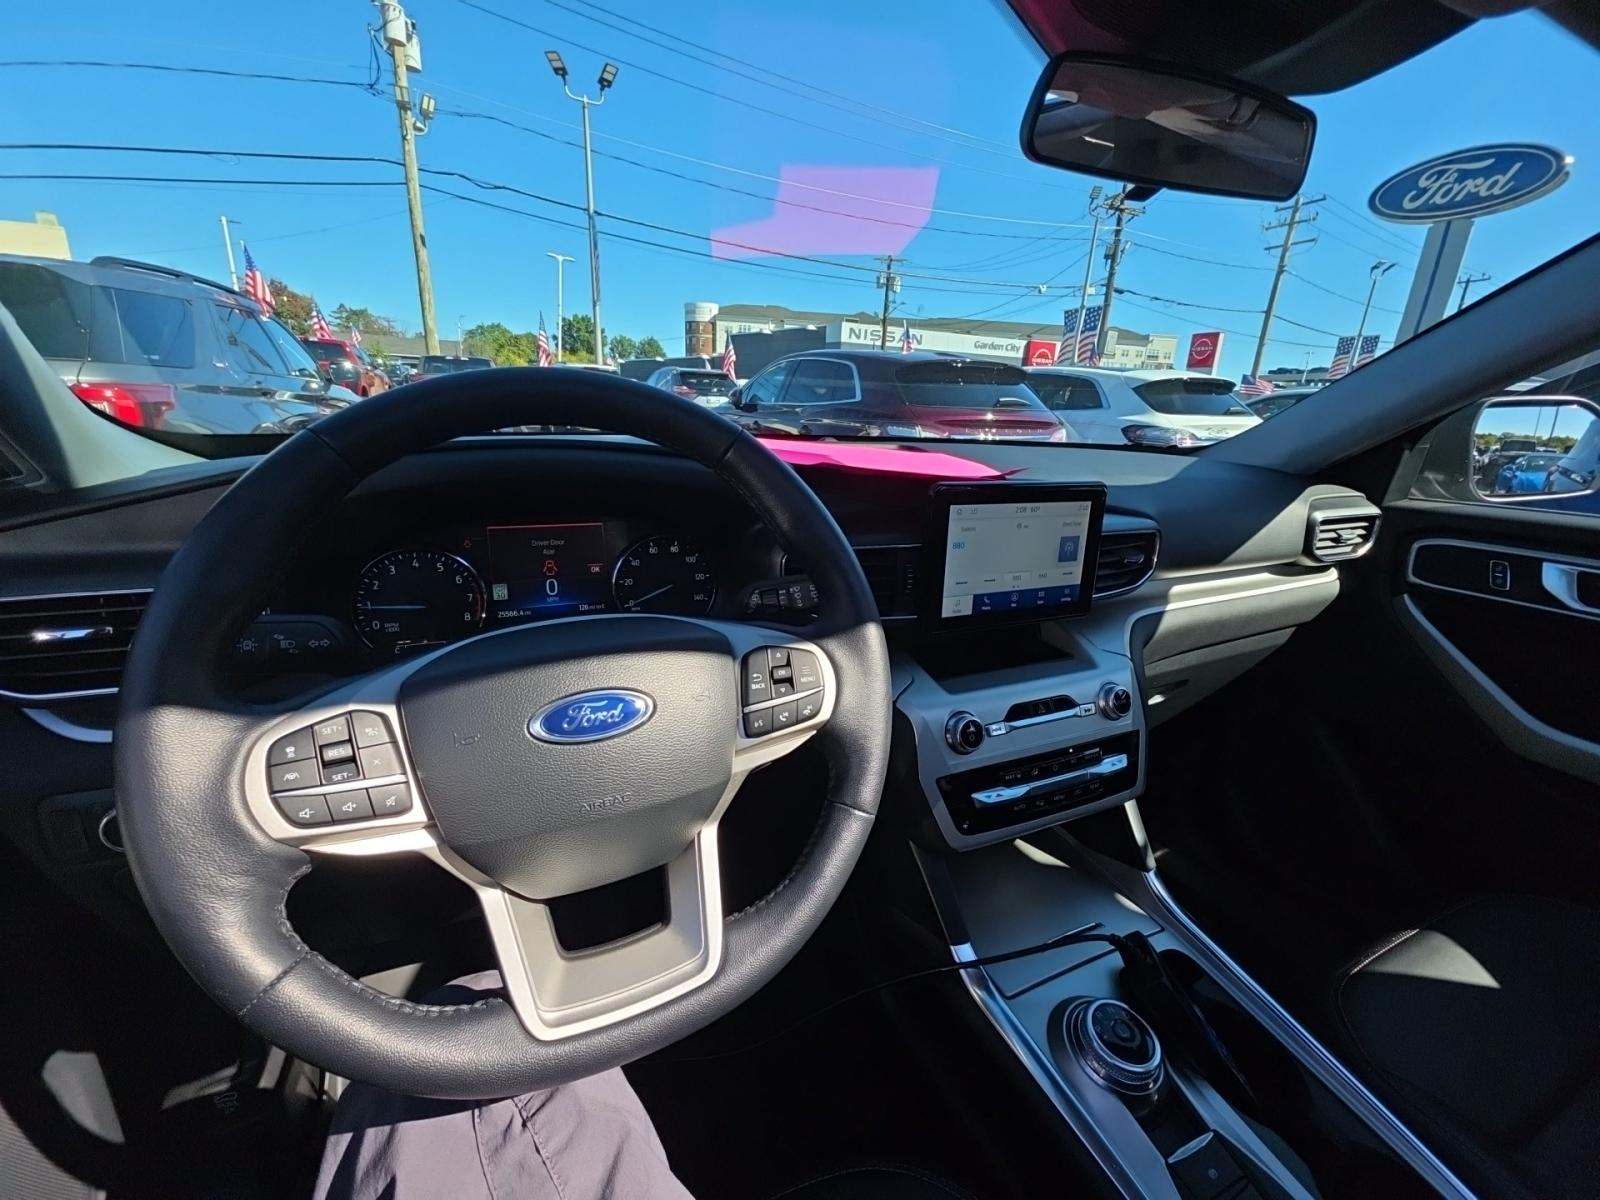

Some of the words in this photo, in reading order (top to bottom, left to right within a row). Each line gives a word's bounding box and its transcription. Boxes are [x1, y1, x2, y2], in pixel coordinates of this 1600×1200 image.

[1402, 158, 1523, 210] Ford
[974, 341, 1004, 352] Garden
[1005, 343, 1020, 353] City
[412, 559, 420, 568] 4
[437, 562, 444, 572] 5
[389, 565, 396, 575] 3
[455, 575, 462, 584] 6
[372, 581, 380, 590] 2
[546, 578, 558, 595] 0
[464, 612, 471, 621] 8
[372, 621, 380, 630] 0
[562, 700, 624, 731] Ford
[328, 747, 345, 757] RES
[578, 793, 632, 814] AIRBAG
